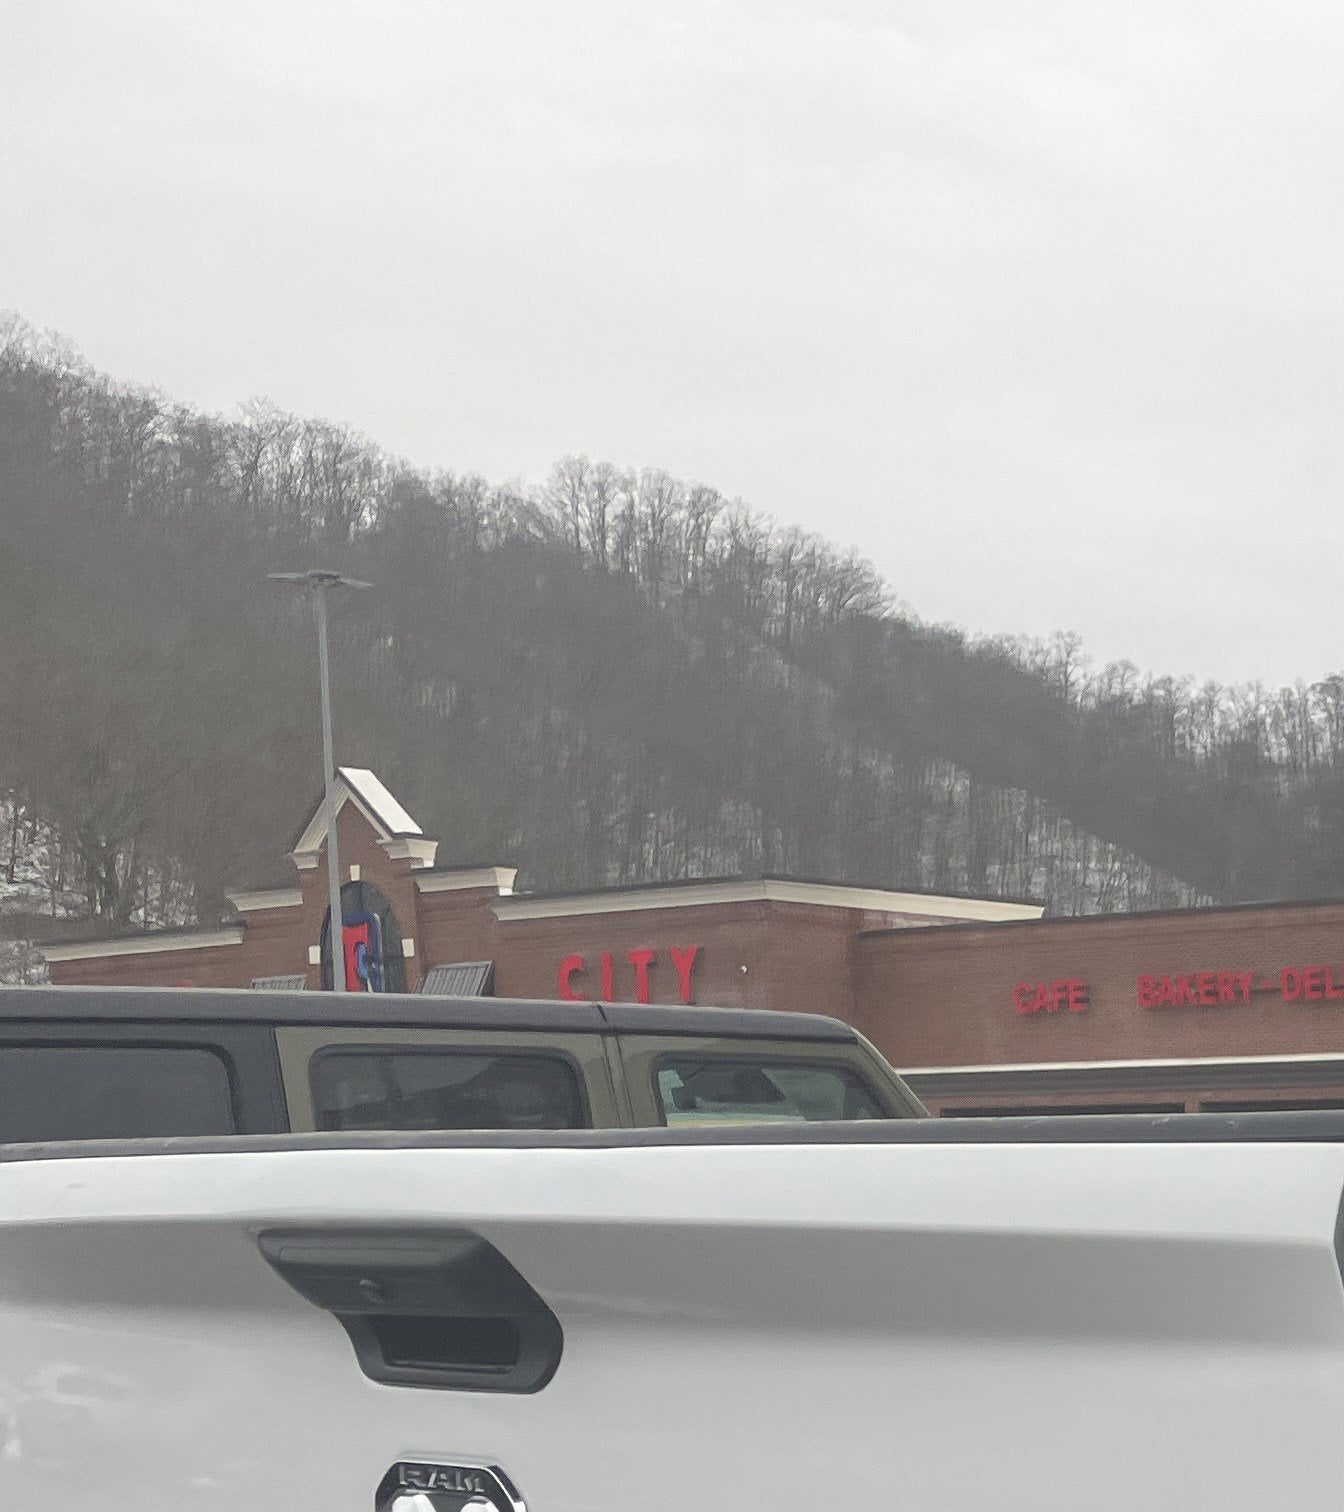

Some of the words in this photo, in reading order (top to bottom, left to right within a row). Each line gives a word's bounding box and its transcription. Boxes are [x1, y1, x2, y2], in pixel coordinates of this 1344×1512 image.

[558, 946, 697, 1004] CITY
[1012, 978, 1089, 1014] CAFE
[399, 1465, 486, 1493] RAM
